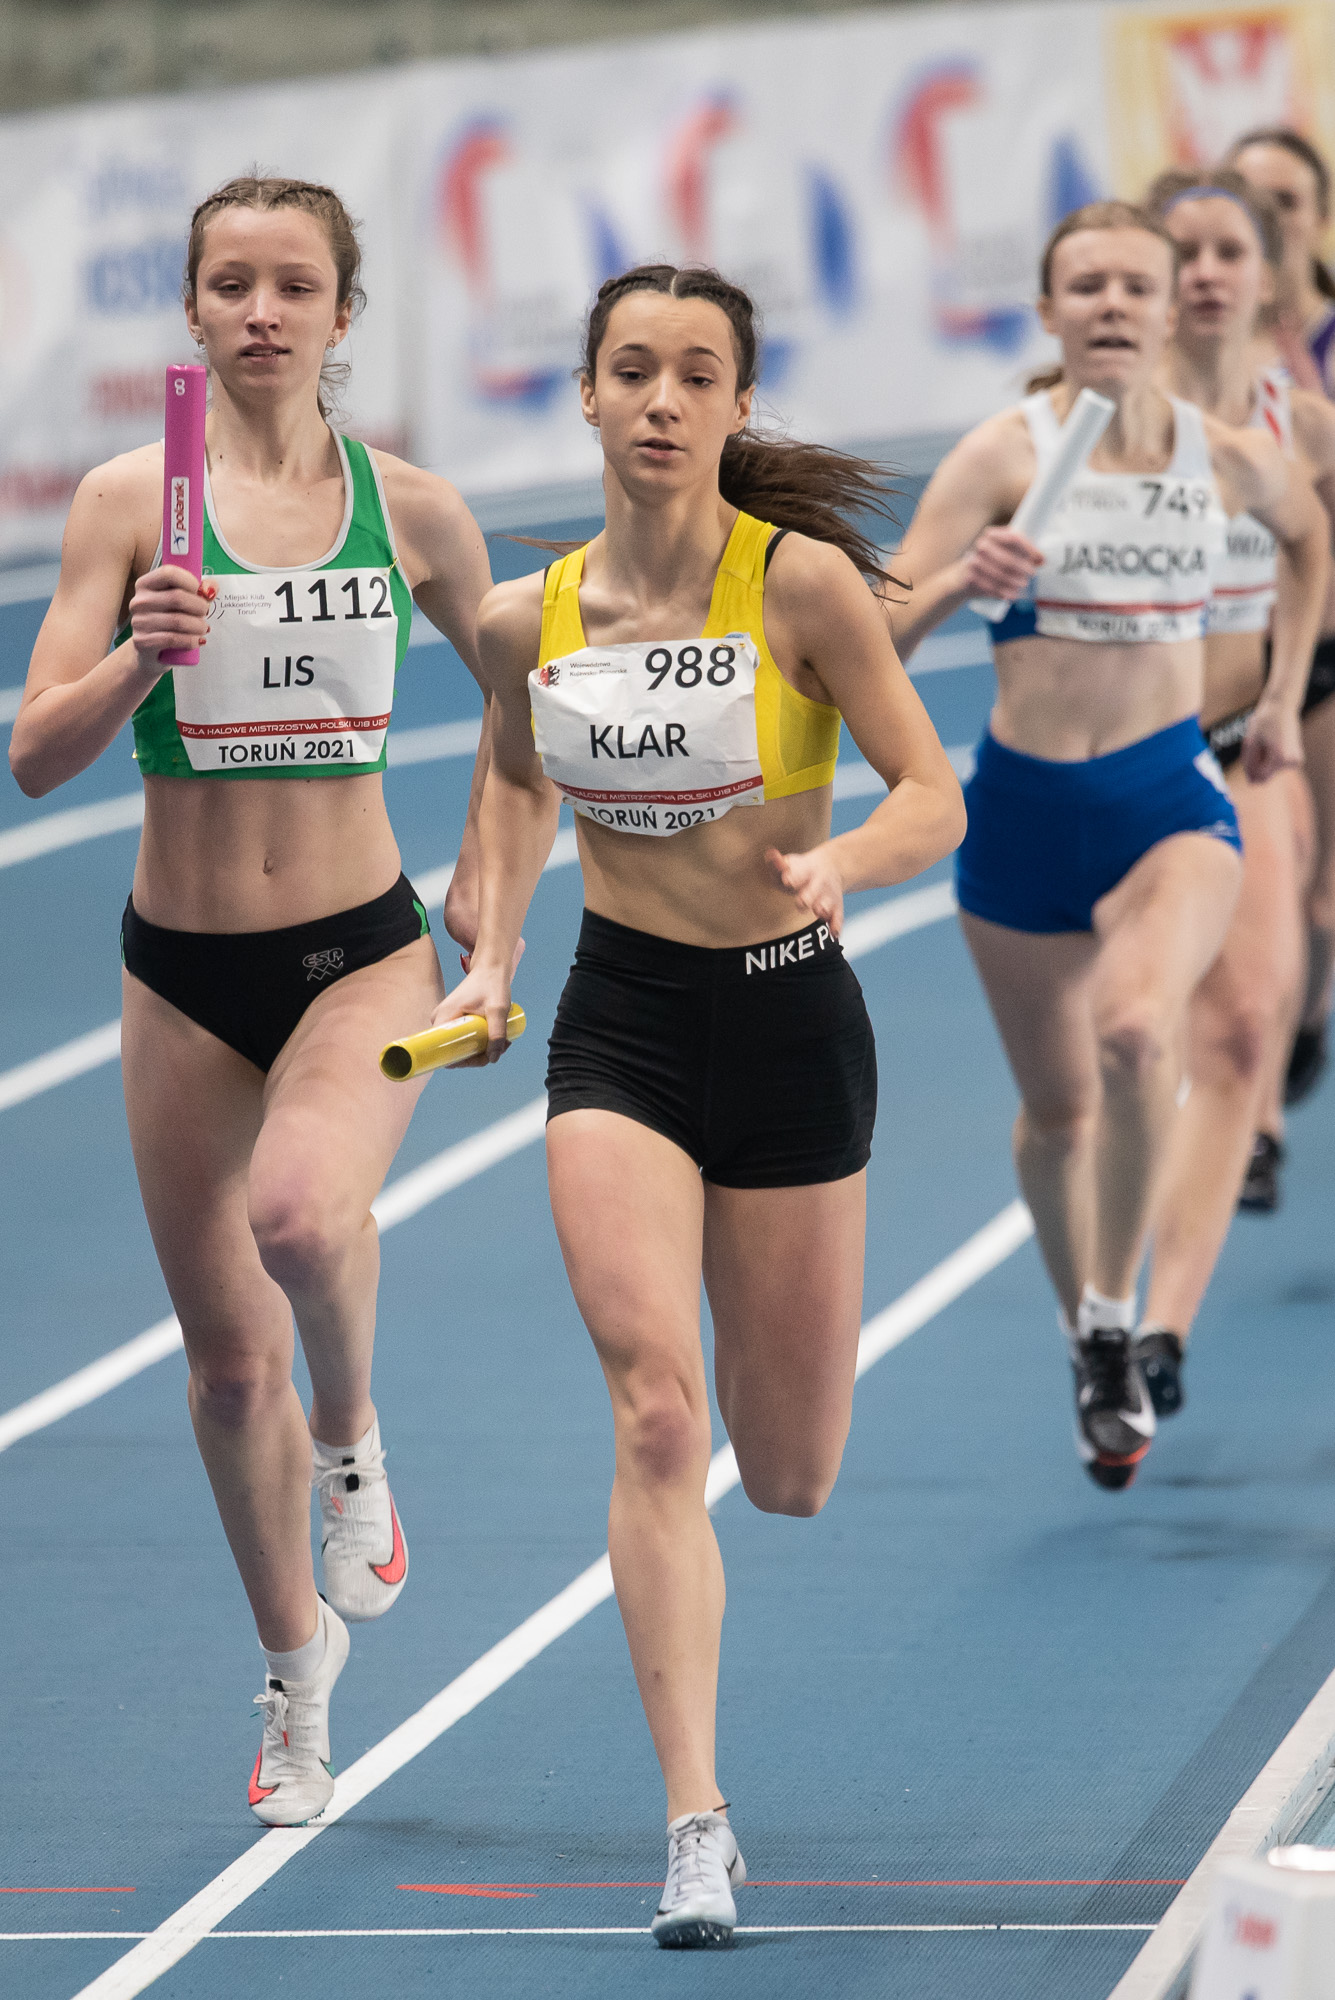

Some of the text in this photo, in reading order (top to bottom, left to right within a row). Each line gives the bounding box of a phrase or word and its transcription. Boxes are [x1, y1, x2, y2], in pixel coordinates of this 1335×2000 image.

[174, 378, 186, 396] 8
[174, 480, 187, 531] polanik
[1058, 543, 1206, 577] JAROCKA
[224, 594, 249, 602] Miejski
[237, 608, 257, 616] Toruń
[275, 576, 392, 623] 1112
[263, 655, 315, 689] LIS
[645, 646, 736, 691] 988
[182, 717, 388, 736] PZLA HALOWE MISTRZOSTWA POLSKI U18 U20
[589, 723, 690, 759] KLAR
[219, 736, 355, 764] TORUŃ 2021
[572, 789, 608, 801] HALOWE
[677, 791, 713, 802] POLSKI
[713, 787, 731, 798] U18
[732, 781, 754, 793] U20
[587, 805, 716, 830] TORUŃ 2021
[745, 932, 815, 975] NIKE
